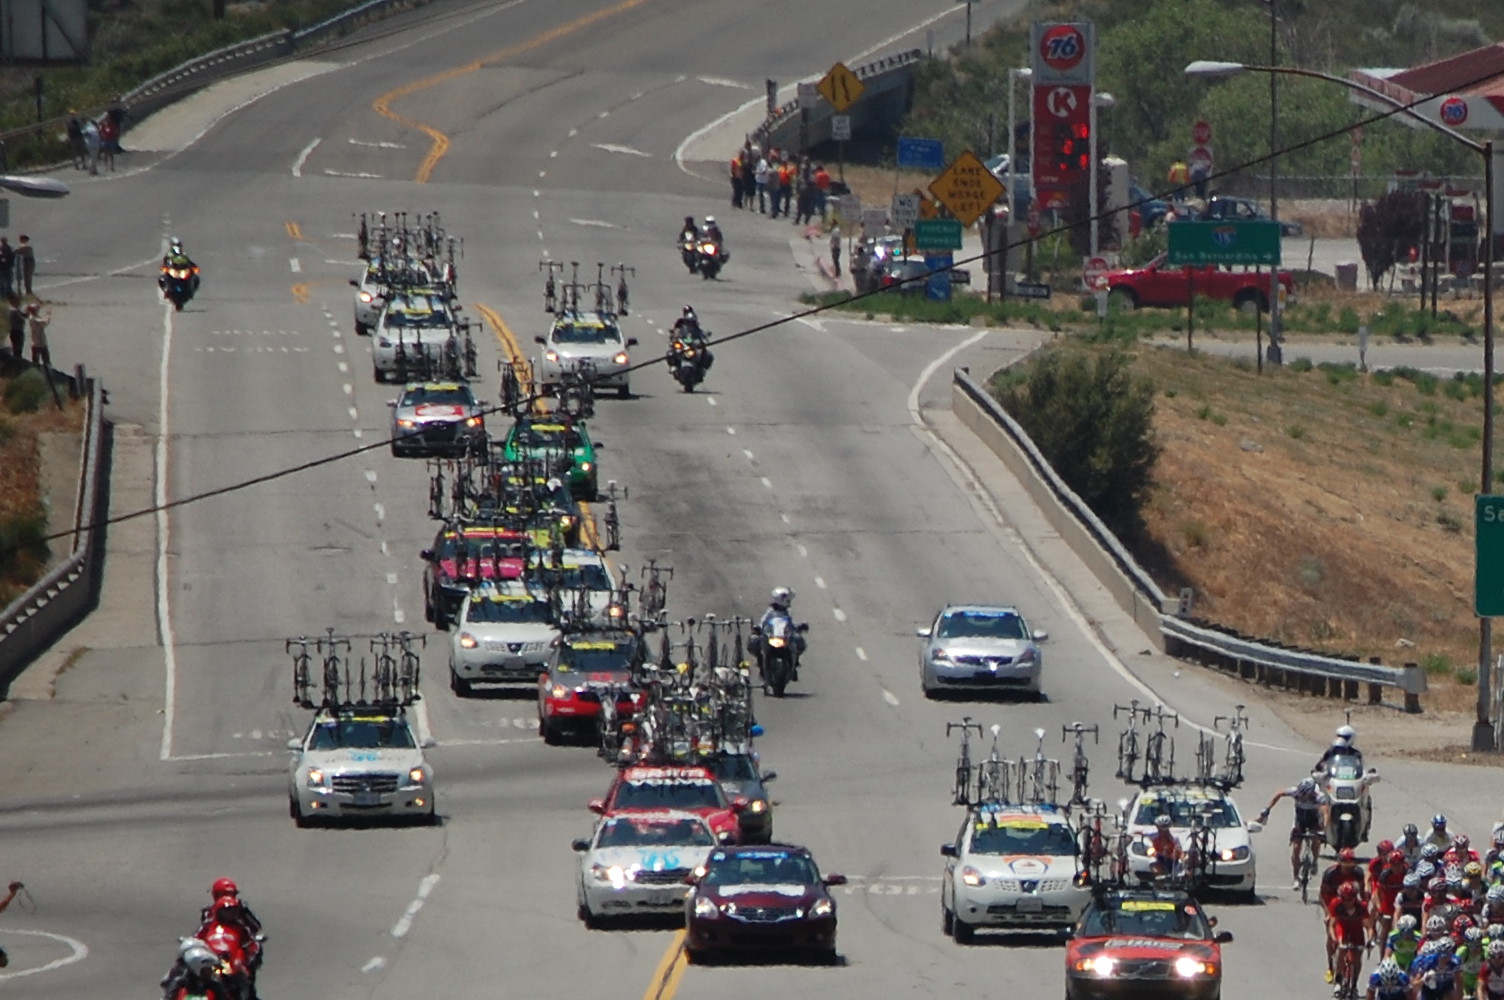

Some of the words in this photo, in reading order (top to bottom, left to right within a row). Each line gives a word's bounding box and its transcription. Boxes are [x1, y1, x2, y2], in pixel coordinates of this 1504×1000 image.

[1047, 33, 1077, 59] 76
[1048, 88, 1077, 116] K
[953, 167, 981, 175] LANE
[953, 179, 981, 187] ENDS
[948, 190, 985, 198] MERGE
[953, 204, 981, 212] LEFT
